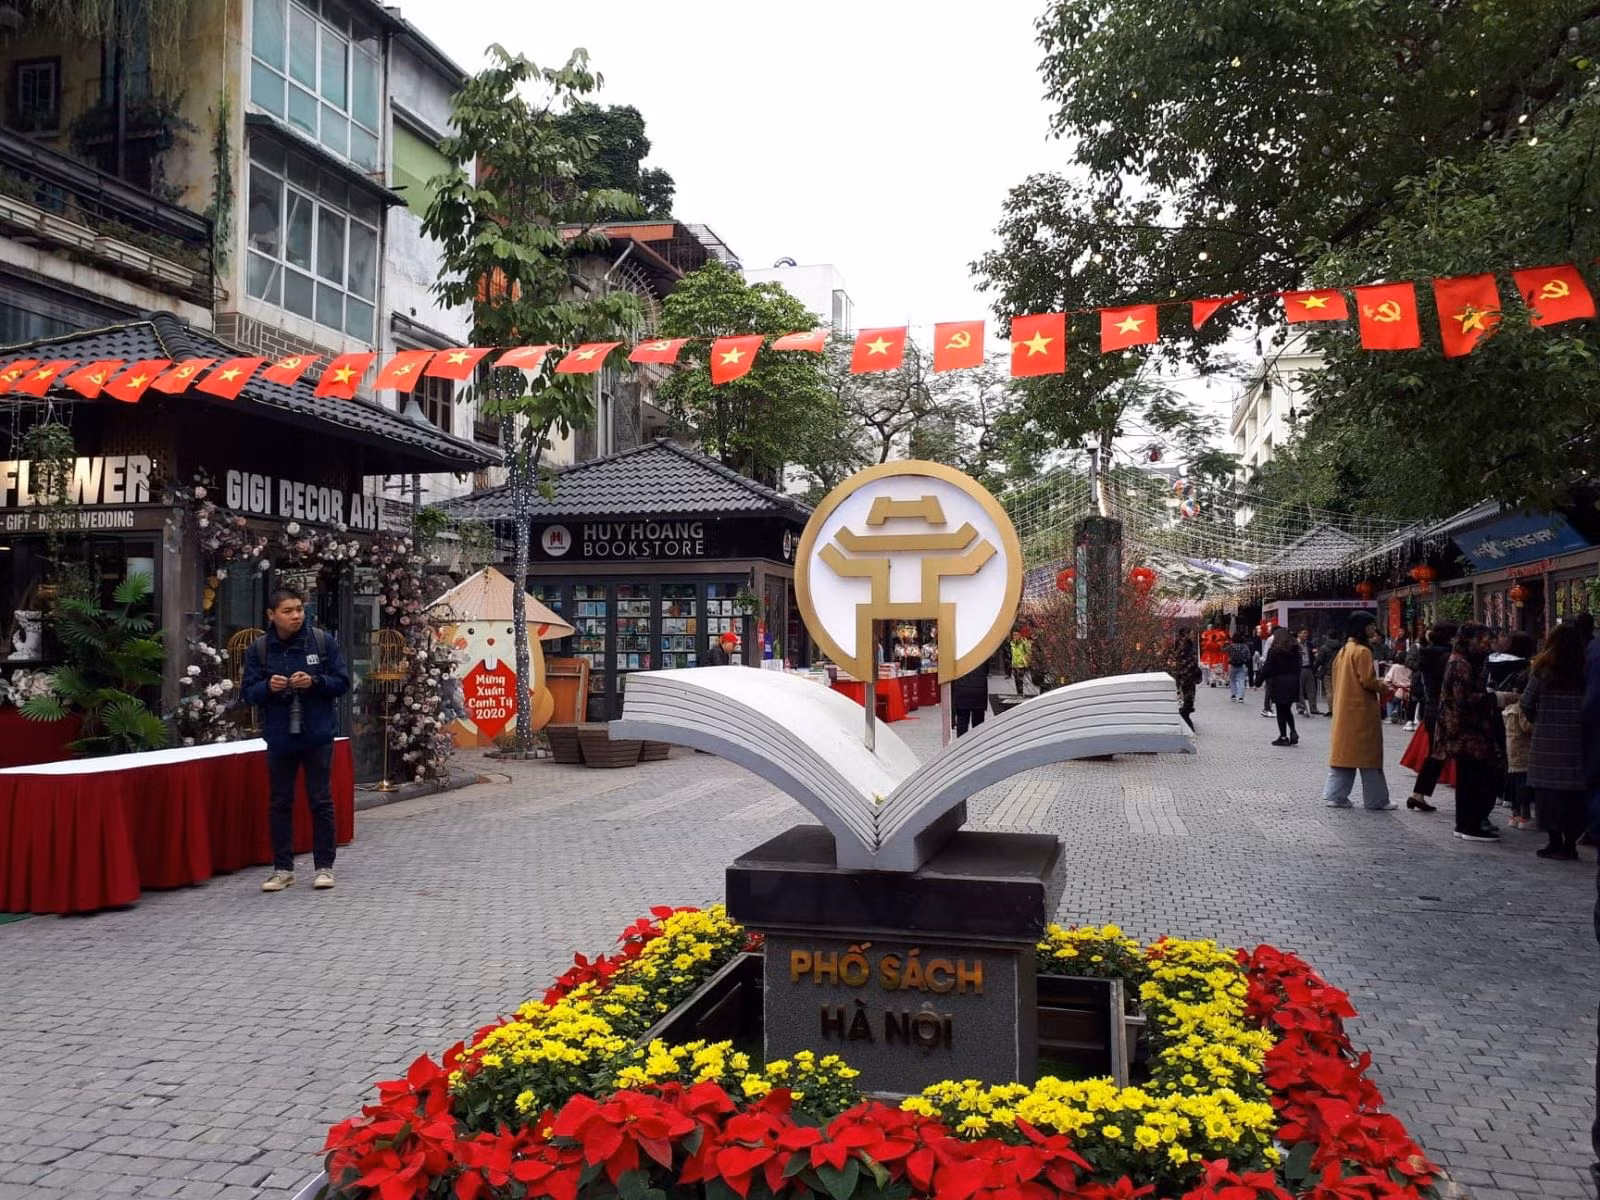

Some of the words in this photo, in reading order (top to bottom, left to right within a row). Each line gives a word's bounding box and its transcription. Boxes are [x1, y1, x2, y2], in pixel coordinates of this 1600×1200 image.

[0, 455, 151, 507] FLOWER
[226, 469, 272, 514] GIGI
[279, 479, 344, 525] DECOR
[350, 492, 387, 531] ART
[6, 514, 31, 531] GIFT
[79, 510, 134, 529] WEDDING
[583, 523, 625, 540] HUY
[631, 522, 704, 539] HOANG
[584, 541, 704, 556] BOOKSTORE
[468, 697, 496, 708] Canh
[476, 708, 506, 719] 2020
[790, 941, 872, 986] PHỐ
[879, 947, 985, 994] SÁCH
[820, 997, 875, 1042] HÀ
[884, 1000, 954, 1050] NỘI
